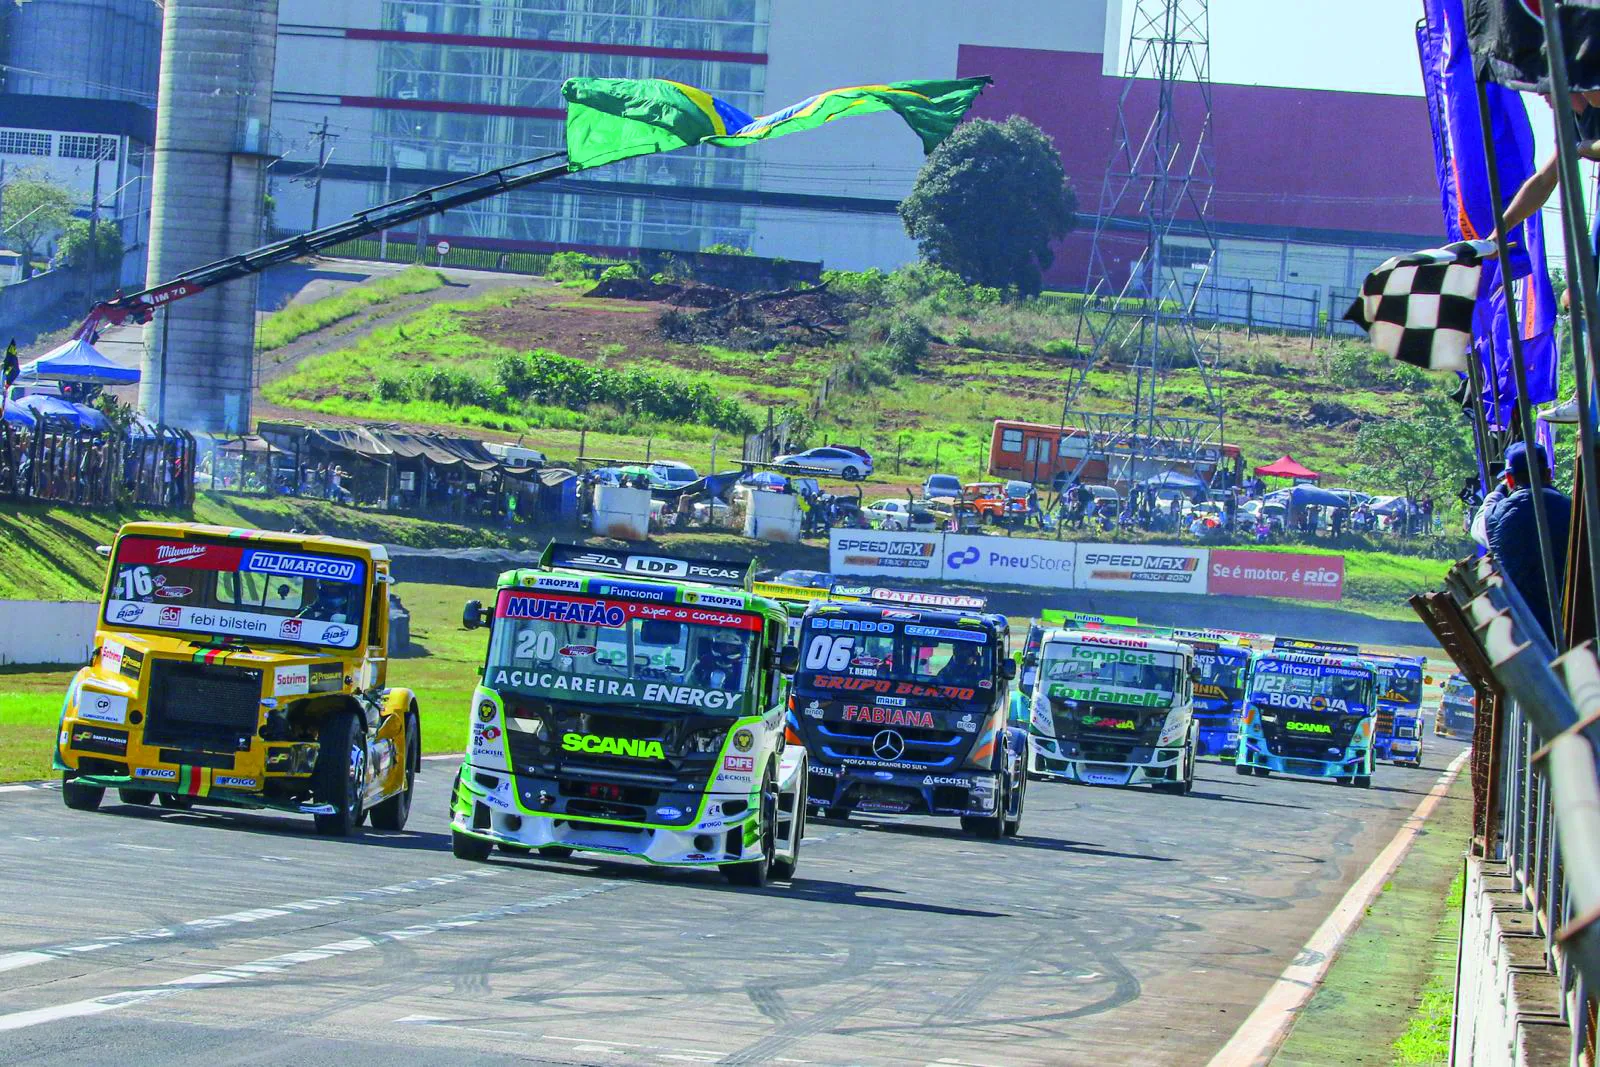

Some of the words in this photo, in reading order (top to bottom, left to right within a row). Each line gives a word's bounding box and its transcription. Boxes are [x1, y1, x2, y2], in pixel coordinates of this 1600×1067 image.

[171, 287, 186, 296] 70
[156, 544, 207, 559] Milwaukee
[838, 539, 887, 553] SPEED
[889, 542, 924, 556] MAX
[637, 559, 678, 573] LDP
[690, 566, 739, 578] PEÇAS
[990, 551, 1072, 572] PneuStore
[1084, 554, 1143, 566] SPEED
[1144, 557, 1185, 571] MAX
[1212, 564, 1229, 578] Se
[1233, 564, 1240, 579] é
[1292, 568, 1299, 582] é
[539, 578, 579, 589] TROPPA
[610, 586, 664, 600] Funcional
[700, 595, 742, 607] TROPPA
[117, 606, 144, 619] Biasi
[507, 597, 625, 626] MUFFATÃO
[675, 609, 687, 618] do
[692, 612, 742, 624] coração
[1075, 613, 1105, 623] Infinity
[191, 613, 215, 626] febi
[220, 614, 267, 631] bilstein
[322, 629, 349, 641] Biasi
[1081, 635, 1148, 648] FACCHINI
[515, 630, 556, 660] 20
[805, 635, 855, 671] 06
[855, 667, 877, 676] BENDO
[1281, 663, 1320, 677] fitazul
[1325, 667, 1369, 678] DISTRIBUIDORA
[495, 670, 636, 697] AÇUCAREIRA
[643, 683, 742, 710] ENERGY
[813, 675, 891, 693] GRUPO
[1048, 682, 1171, 708] Fontanella
[1269, 692, 1349, 713] BIONOVA
[98, 700, 109, 708] CP
[846, 705, 934, 728] FABIANA
[1286, 721, 1331, 734] SCANIA
[561, 732, 666, 760] SCANIA
[146, 768, 176, 777] TOIGO
[225, 776, 256, 786] TOIGO
[933, 776, 971, 786] ECKISIL
